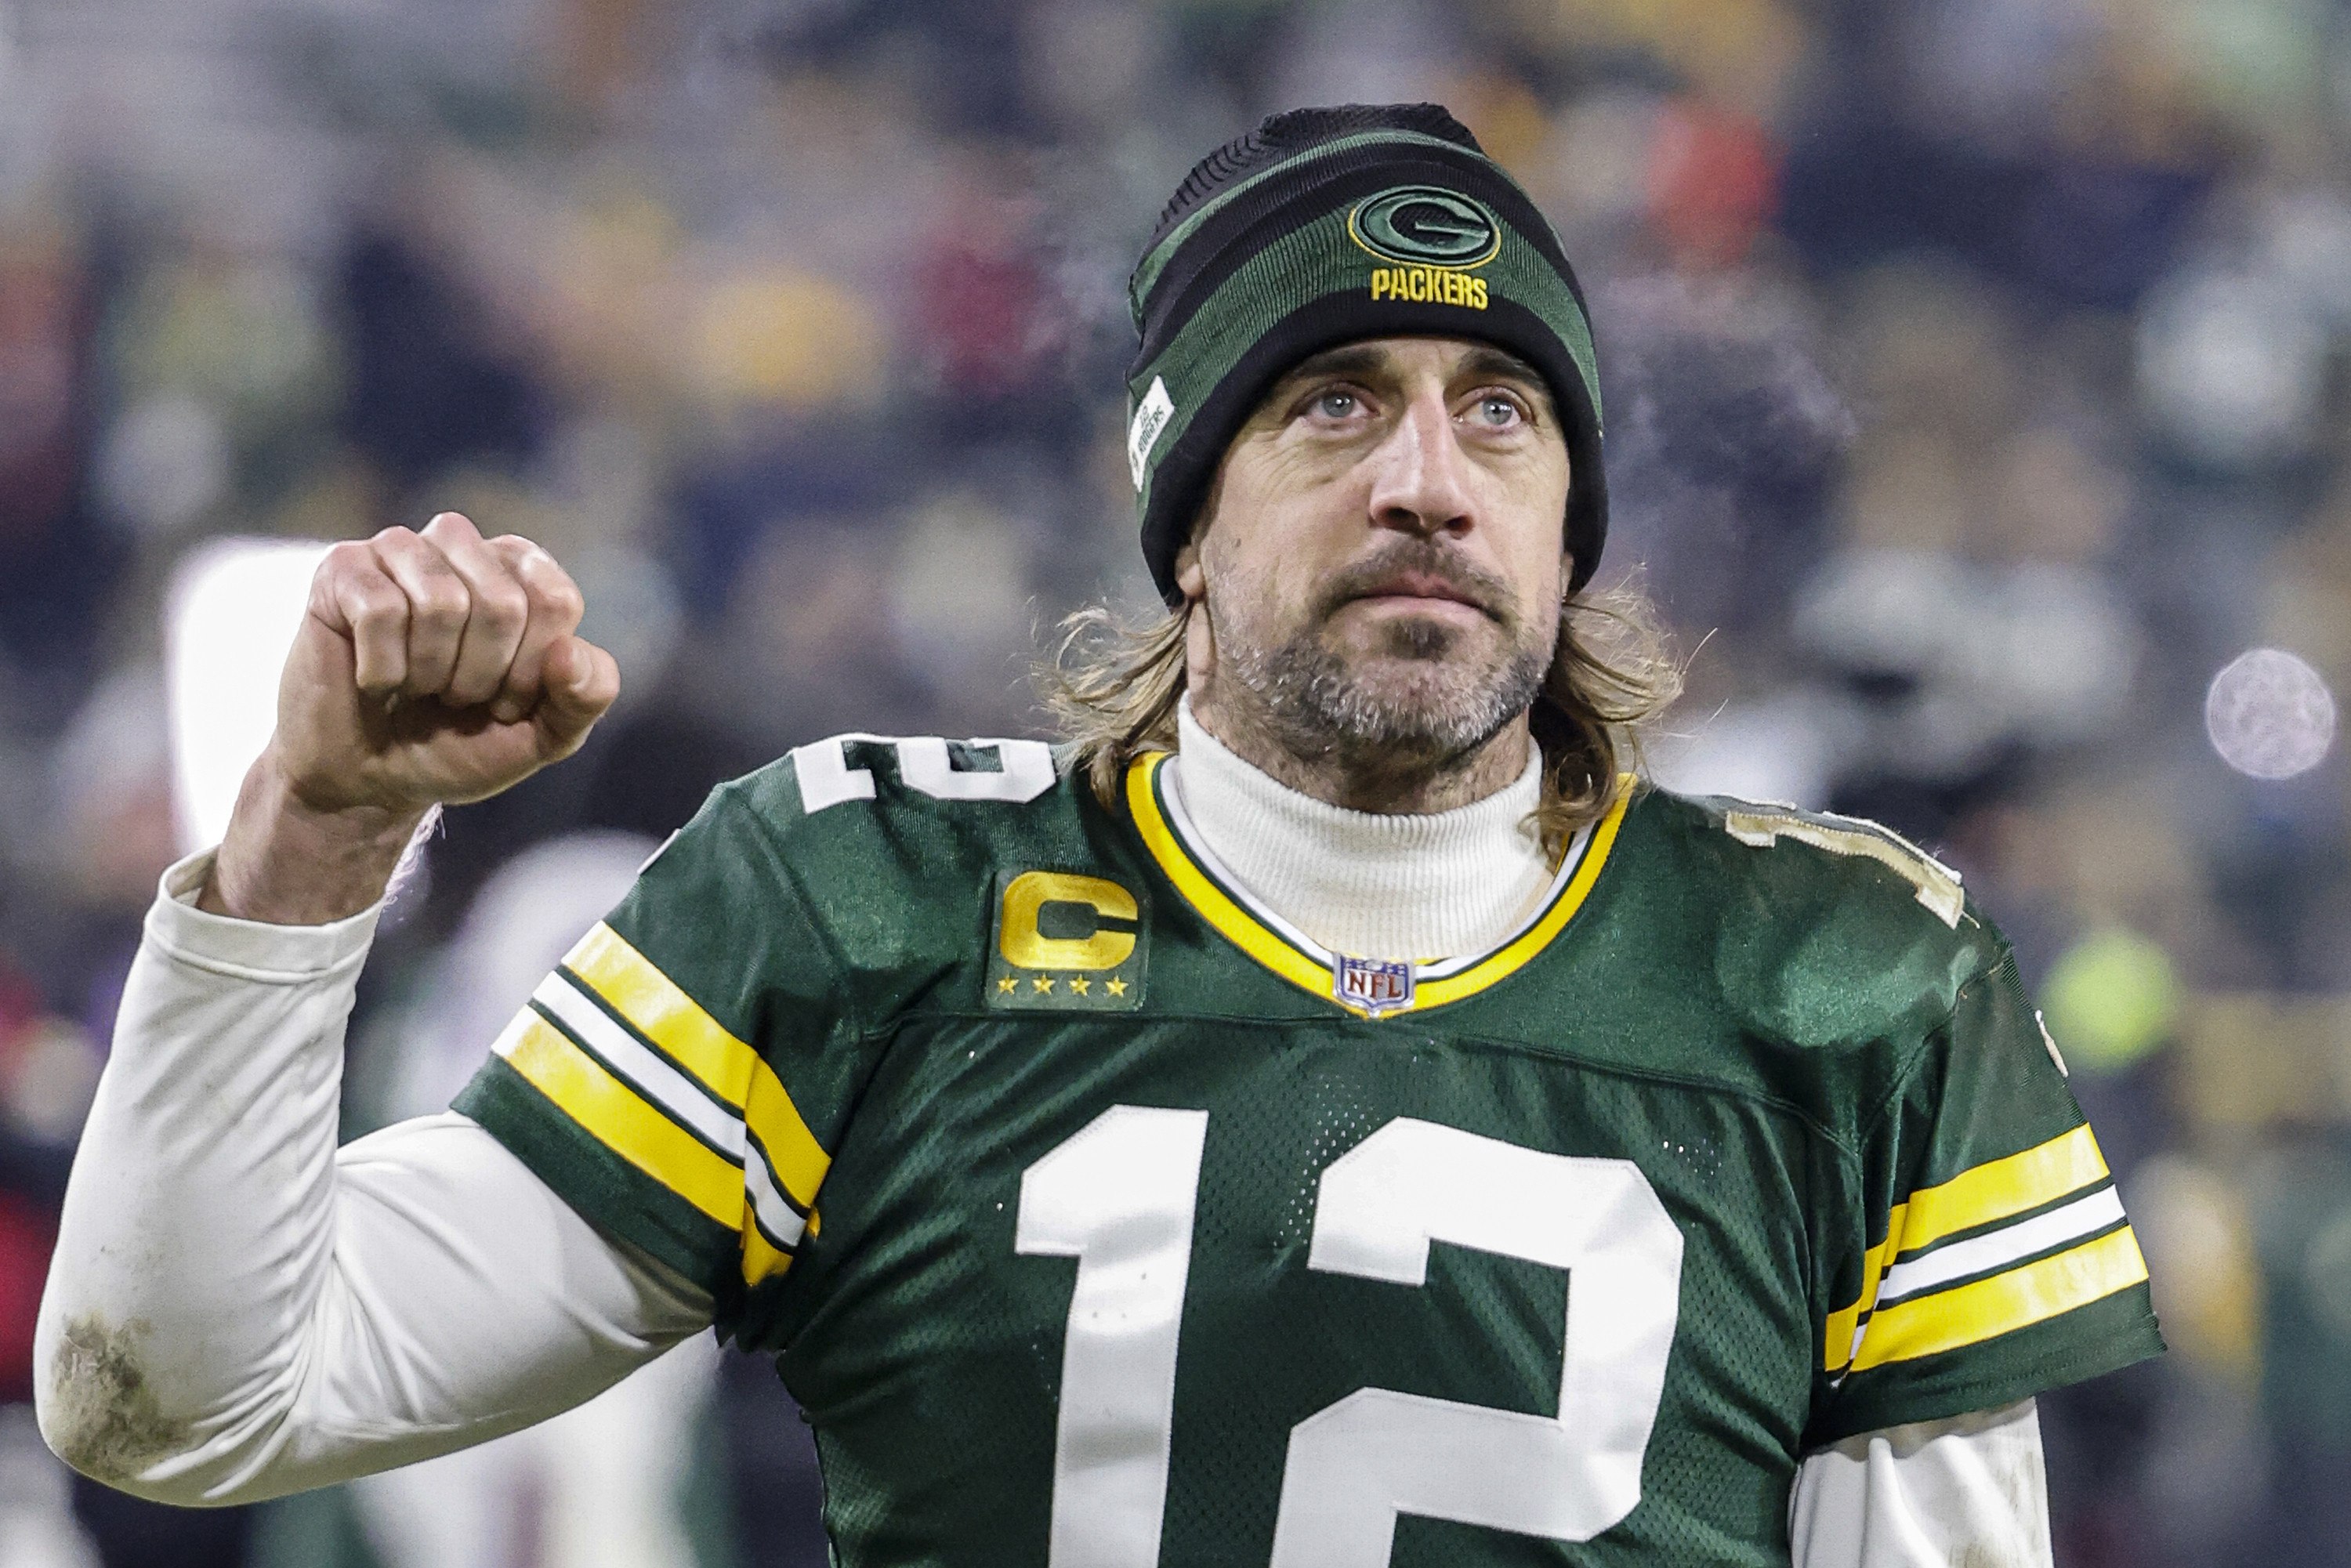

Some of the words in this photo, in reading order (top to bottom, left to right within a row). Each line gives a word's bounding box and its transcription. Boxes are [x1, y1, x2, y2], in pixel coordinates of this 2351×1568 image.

[1364, 193, 1490, 255] G
[1372, 268, 1488, 310] PACKERS
[1000, 871, 1138, 970] C
[1348, 970, 1402, 999] NFL
[1016, 1104, 1684, 1568] 12
